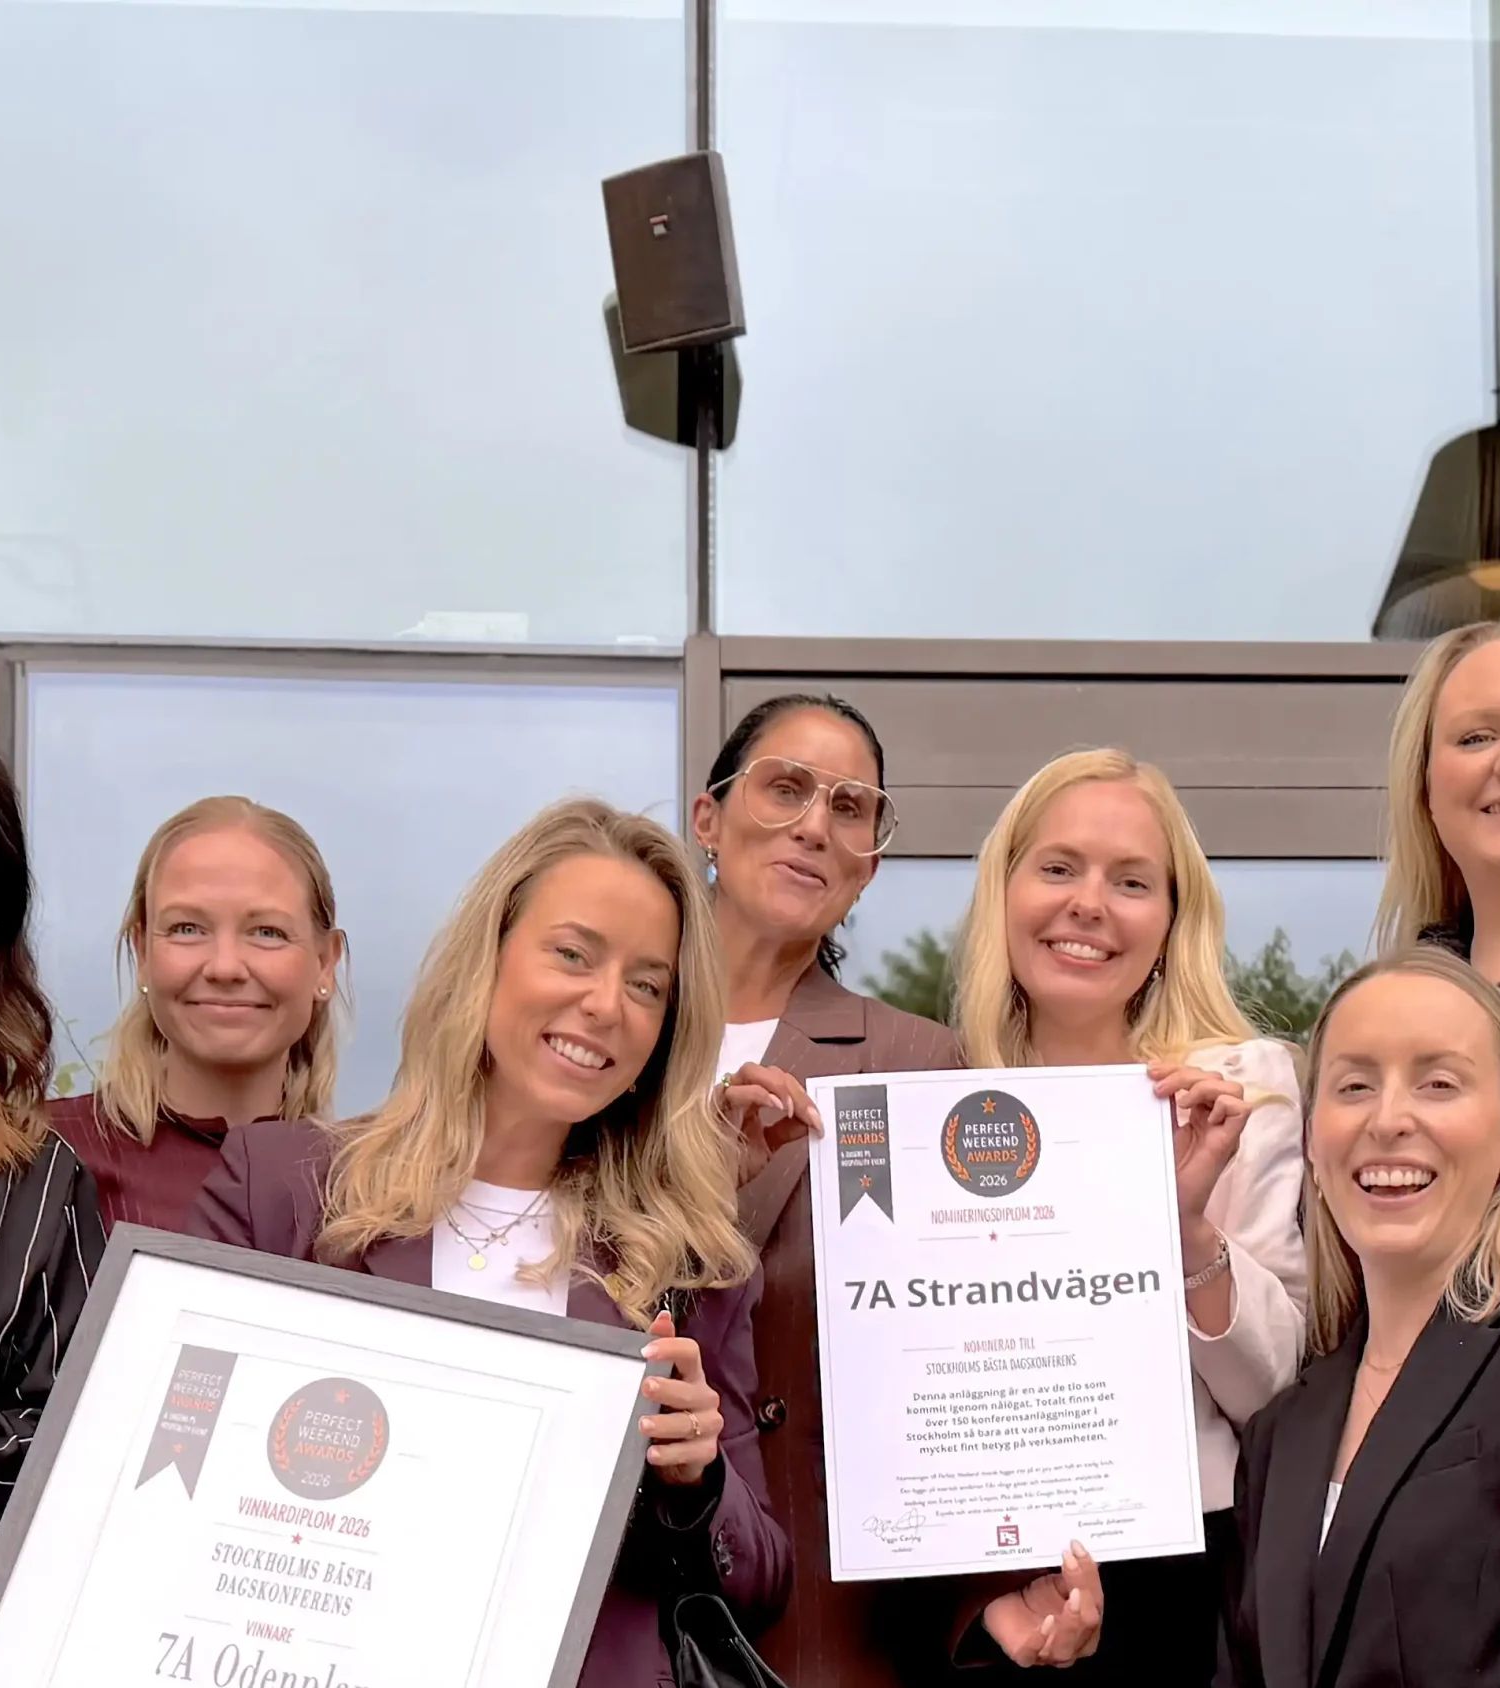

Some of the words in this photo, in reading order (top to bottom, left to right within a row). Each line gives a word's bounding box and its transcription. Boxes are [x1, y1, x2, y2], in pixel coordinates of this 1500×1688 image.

[839, 1109, 882, 1120] PERFECT
[839, 1120, 884, 1131] WEEKEND
[964, 1122, 1015, 1135] PERFECT
[840, 1132, 885, 1144] AWARDS
[962, 1136, 1019, 1148] WEEKEND
[967, 1150, 1018, 1162] AWARDS
[980, 1175, 1008, 1186] 2026
[931, 1206, 1030, 1224] NOMINERINGSDIPLOM
[1033, 1205, 1056, 1220] 2026
[845, 1280, 896, 1310] 7A
[908, 1269, 1160, 1307] Strandvägen
[964, 1338, 1016, 1353] NOMINERAD
[1019, 1337, 1035, 1350] TILL
[926, 1360, 980, 1376] STOCKHOLMS
[983, 1357, 1008, 1372] BÄSTA
[1010, 1354, 1076, 1370] DAGSKONFERENS
[913, 1392, 946, 1401] Denna
[949, 1388, 1006, 1400] anläggning
[1008, 1387, 1019, 1396] är
[1022, 1386, 1035, 1395] en
[1038, 1386, 1050, 1394] av
[1052, 1384, 1065, 1392] de
[1068, 1382, 1082, 1392] tio
[1084, 1381, 1106, 1390] som
[906, 1405, 946, 1415] kommit
[950, 1402, 988, 1414] igenom
[1036, 1396, 1066, 1407] Totalt
[1068, 1394, 1094, 1404] finns
[1097, 1392, 1114, 1401] det
[304, 1410, 363, 1431] PERFECT
[925, 1418, 948, 1428] över
[951, 1416, 969, 1426] 150
[971, 1409, 1092, 1425] konferensanläggningar
[299, 1426, 360, 1448] WEEKEND
[906, 1430, 960, 1442] Stockholm
[964, 1428, 974, 1438] så
[978, 1428, 1002, 1438] bara
[1004, 1426, 1020, 1436] att
[1022, 1426, 1045, 1434] vara
[1048, 1420, 1104, 1432] nominerad
[1108, 1418, 1119, 1427] är
[294, 1442, 356, 1463] AWARDS
[920, 1443, 958, 1456] mycket
[960, 1442, 978, 1452] fint
[982, 1440, 1011, 1451] betyg
[1013, 1438, 1026, 1449] på
[1029, 1432, 1107, 1447] verksamheten.
[301, 1472, 331, 1487] 2026
[238, 1496, 336, 1531] VINNARDIPLOM
[338, 1516, 372, 1538] 2026
[212, 1542, 320, 1580] STOCKHOLMS
[323, 1562, 373, 1591] BÄSTA
[216, 1573, 353, 1616] DAGSKONFERENS
[246, 1620, 295, 1644] VINNARE
[155, 1632, 195, 1681] 7A
